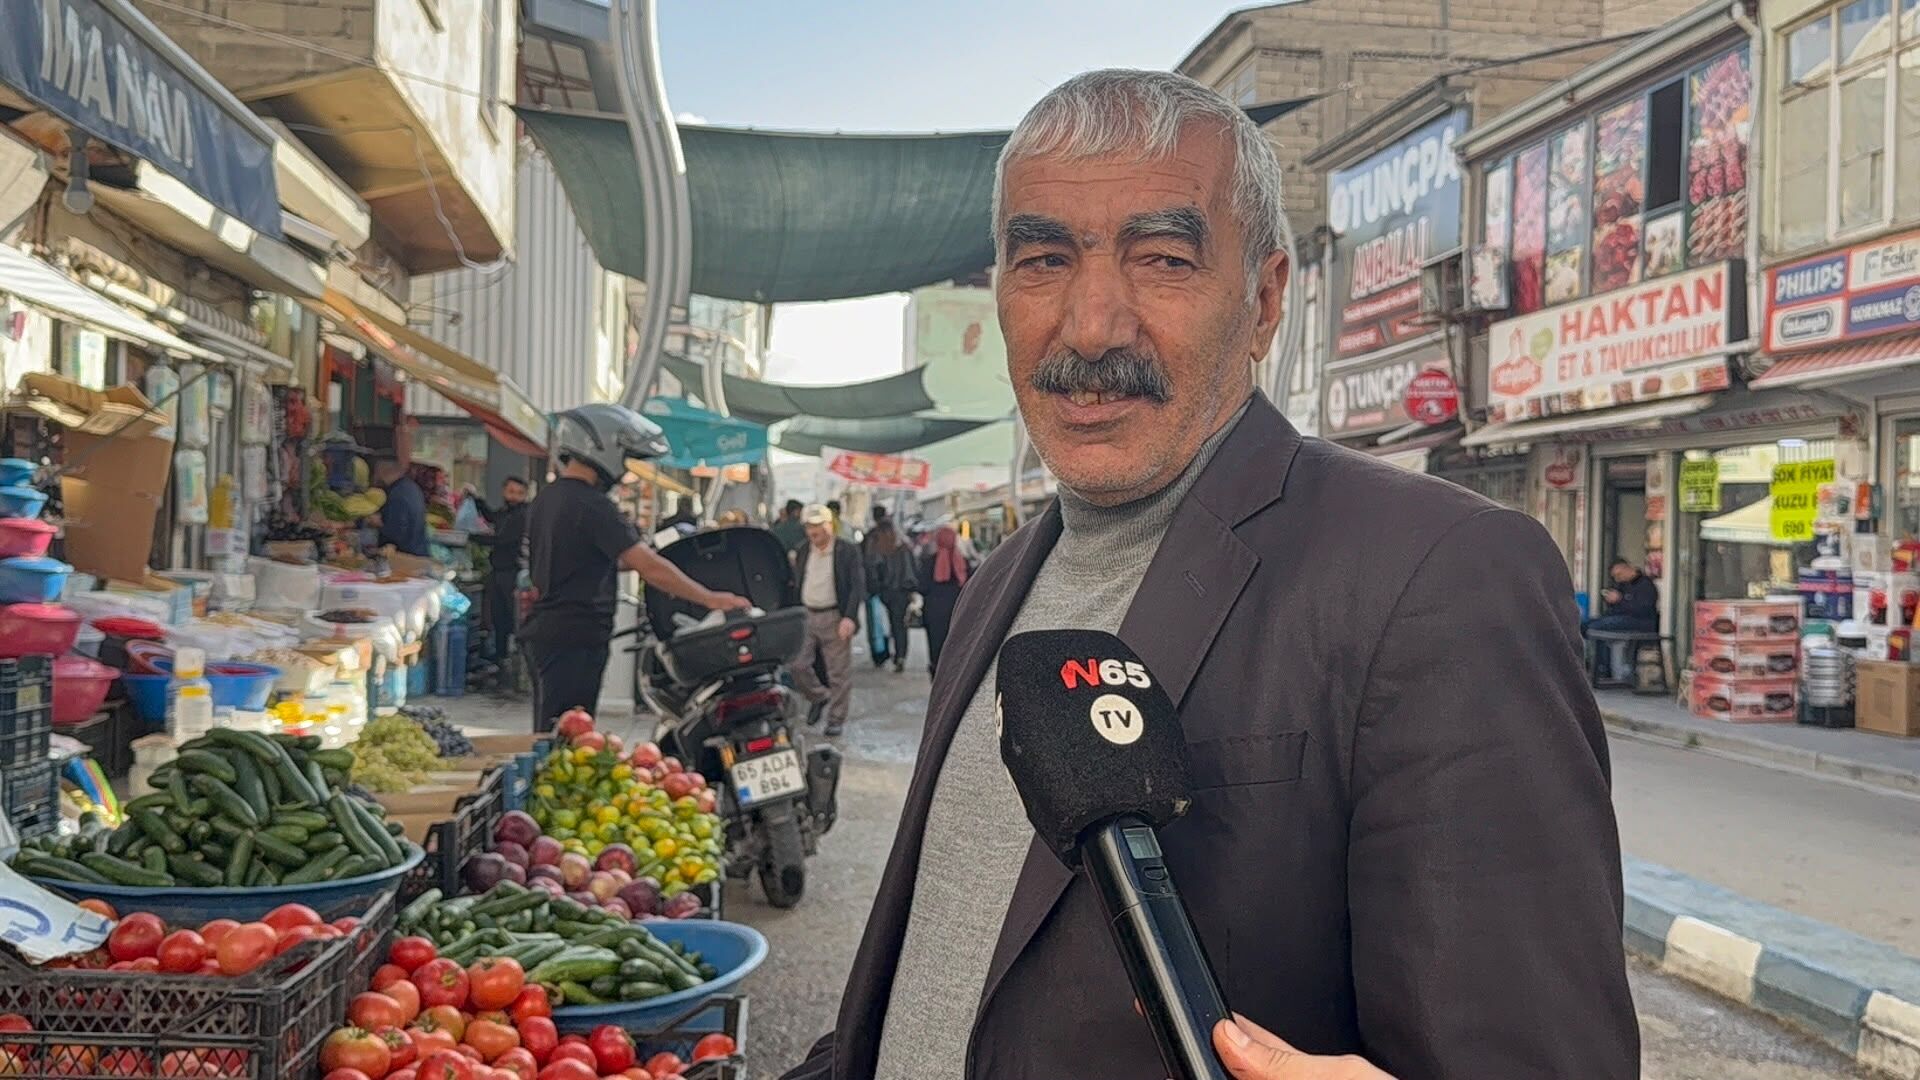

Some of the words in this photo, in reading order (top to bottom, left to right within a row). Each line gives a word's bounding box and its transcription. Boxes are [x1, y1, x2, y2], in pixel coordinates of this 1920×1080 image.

[1775, 260, 1844, 302] PHILIPS
[1559, 271, 1722, 346] HAKTAN
[1558, 352, 1577, 382] ET
[1099, 710, 1131, 729] TV
[737, 763, 757, 782] 65
[762, 753, 795, 776] ADA
